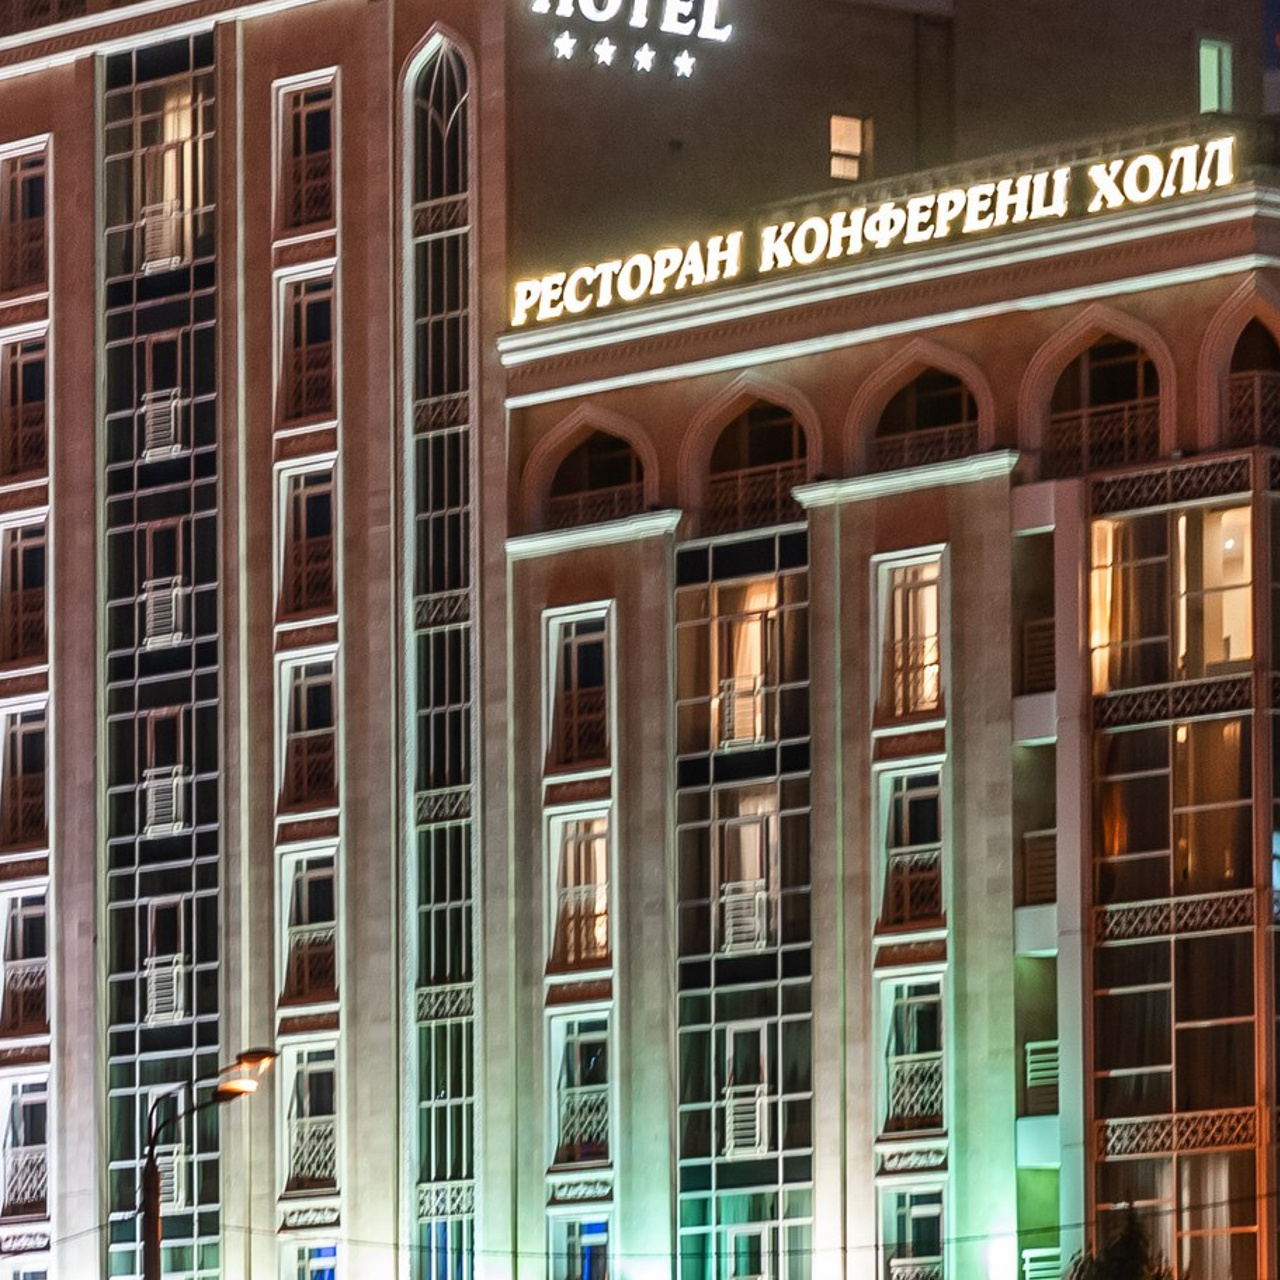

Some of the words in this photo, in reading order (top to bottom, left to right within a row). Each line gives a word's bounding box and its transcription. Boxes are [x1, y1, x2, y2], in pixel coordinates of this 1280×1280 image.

[511, 231, 743, 326] РЕСТОРАН
[758, 167, 1071, 273] КОНФЕРЕНЦ
[1088, 136, 1237, 211] ХОЛЛ
